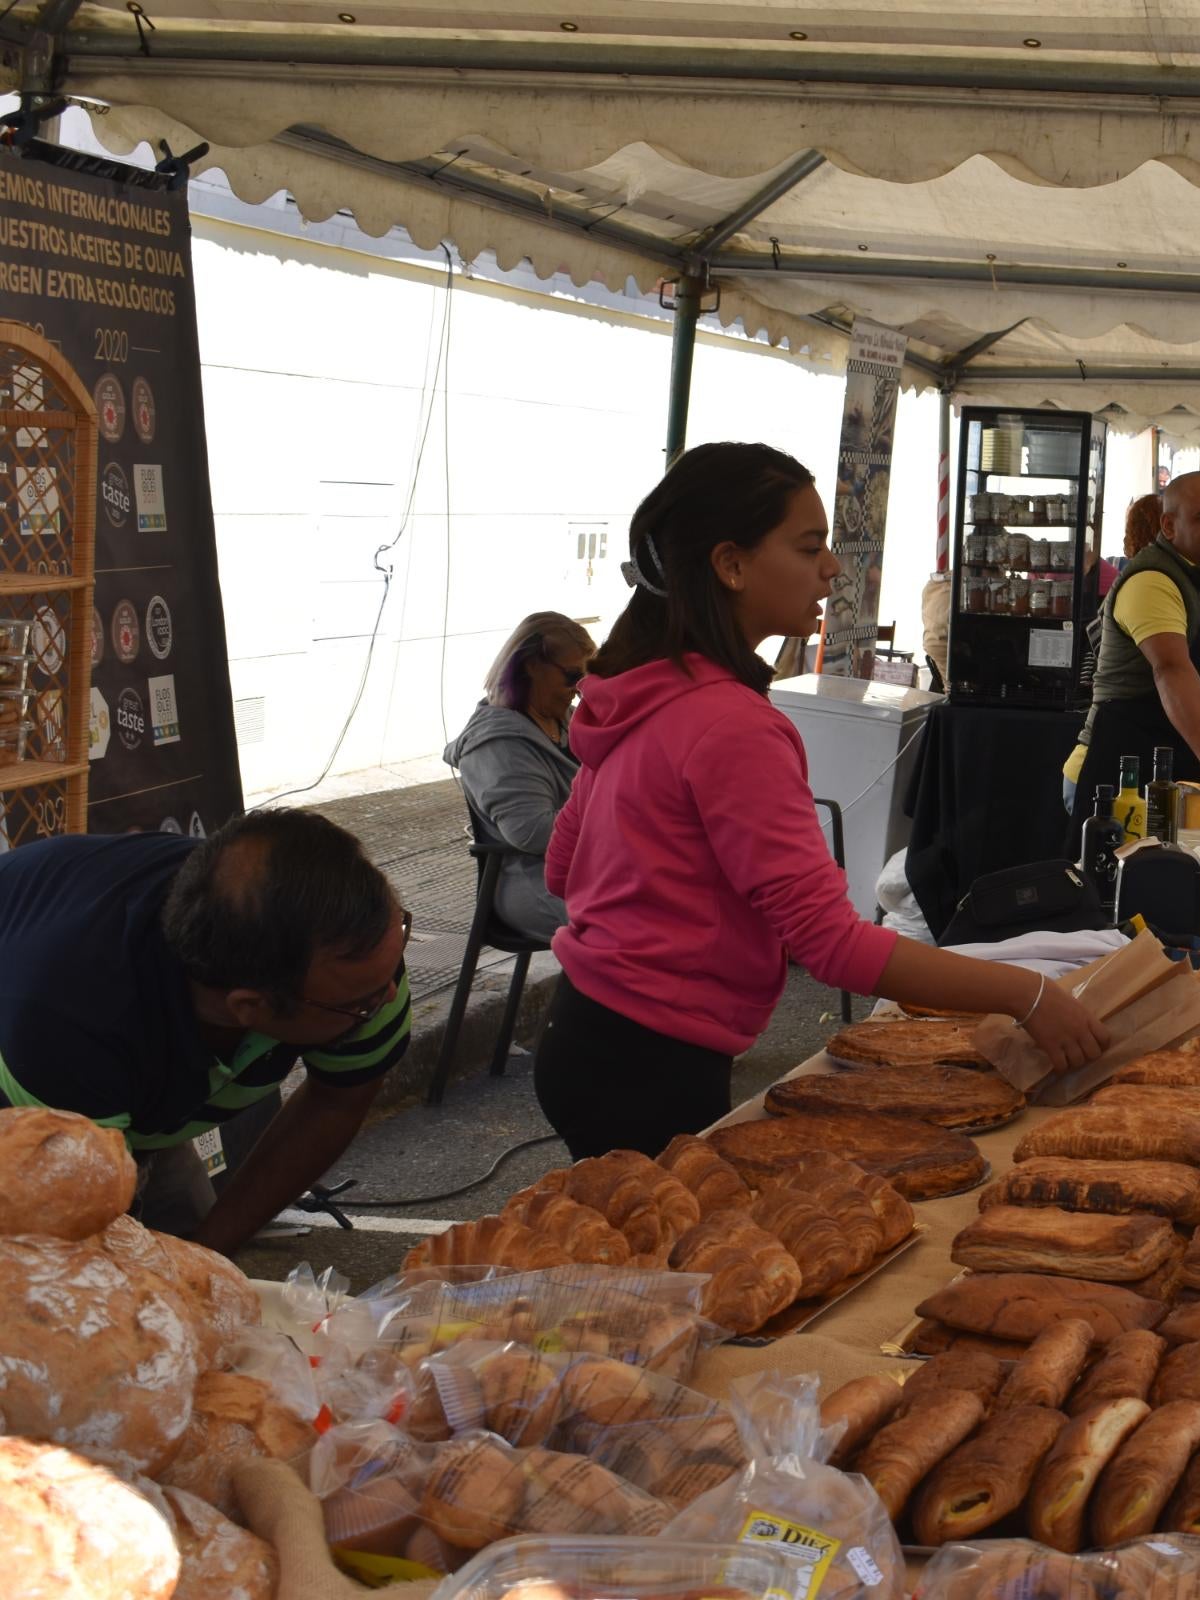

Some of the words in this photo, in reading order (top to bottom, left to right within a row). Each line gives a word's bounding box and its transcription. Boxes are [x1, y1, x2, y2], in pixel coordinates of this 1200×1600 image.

[47, 184, 171, 236] INTERNACIONALES
[70, 232, 121, 267] ACEITES
[124, 243, 143, 270] DE
[145, 247, 185, 277] OLIVA
[47, 269, 96, 303] EXTRA
[96, 278, 175, 316] ECOLÓGICOS
[94, 327, 129, 363] 2020
[102, 481, 130, 512] taste
[117, 708, 145, 733] taste
